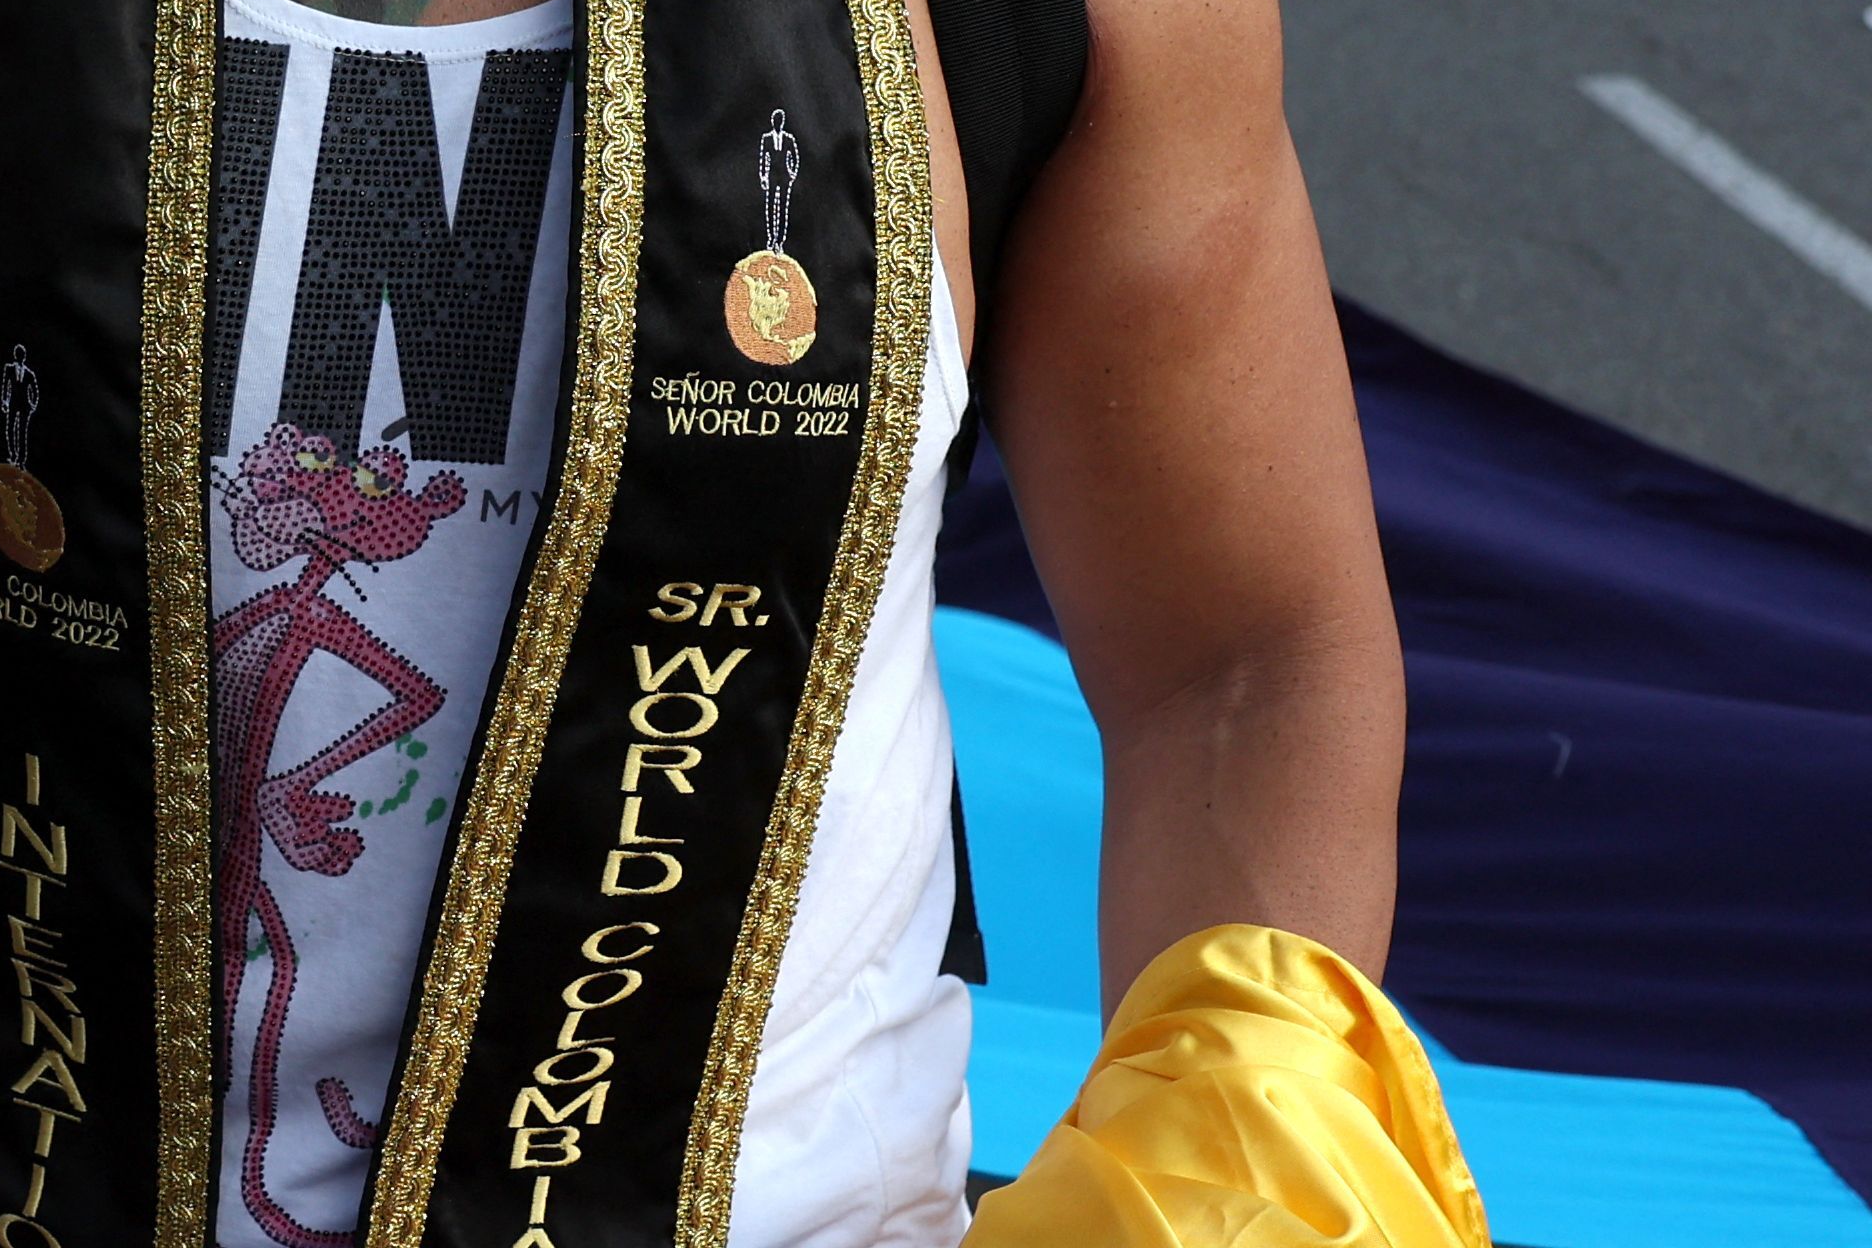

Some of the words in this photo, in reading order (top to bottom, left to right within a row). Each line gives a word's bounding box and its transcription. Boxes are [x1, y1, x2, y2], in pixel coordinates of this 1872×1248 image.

[651, 371, 736, 405] SEÑOR
[747, 380, 860, 408] COLOMBIA
[667, 407, 781, 437] WORLD
[795, 411, 849, 437] 2022
[7, 575, 128, 629] COLOMBIA
[648, 582, 771, 627] SR.
[51, 618, 121, 652] 2022
[600, 645, 752, 896] WORLD
